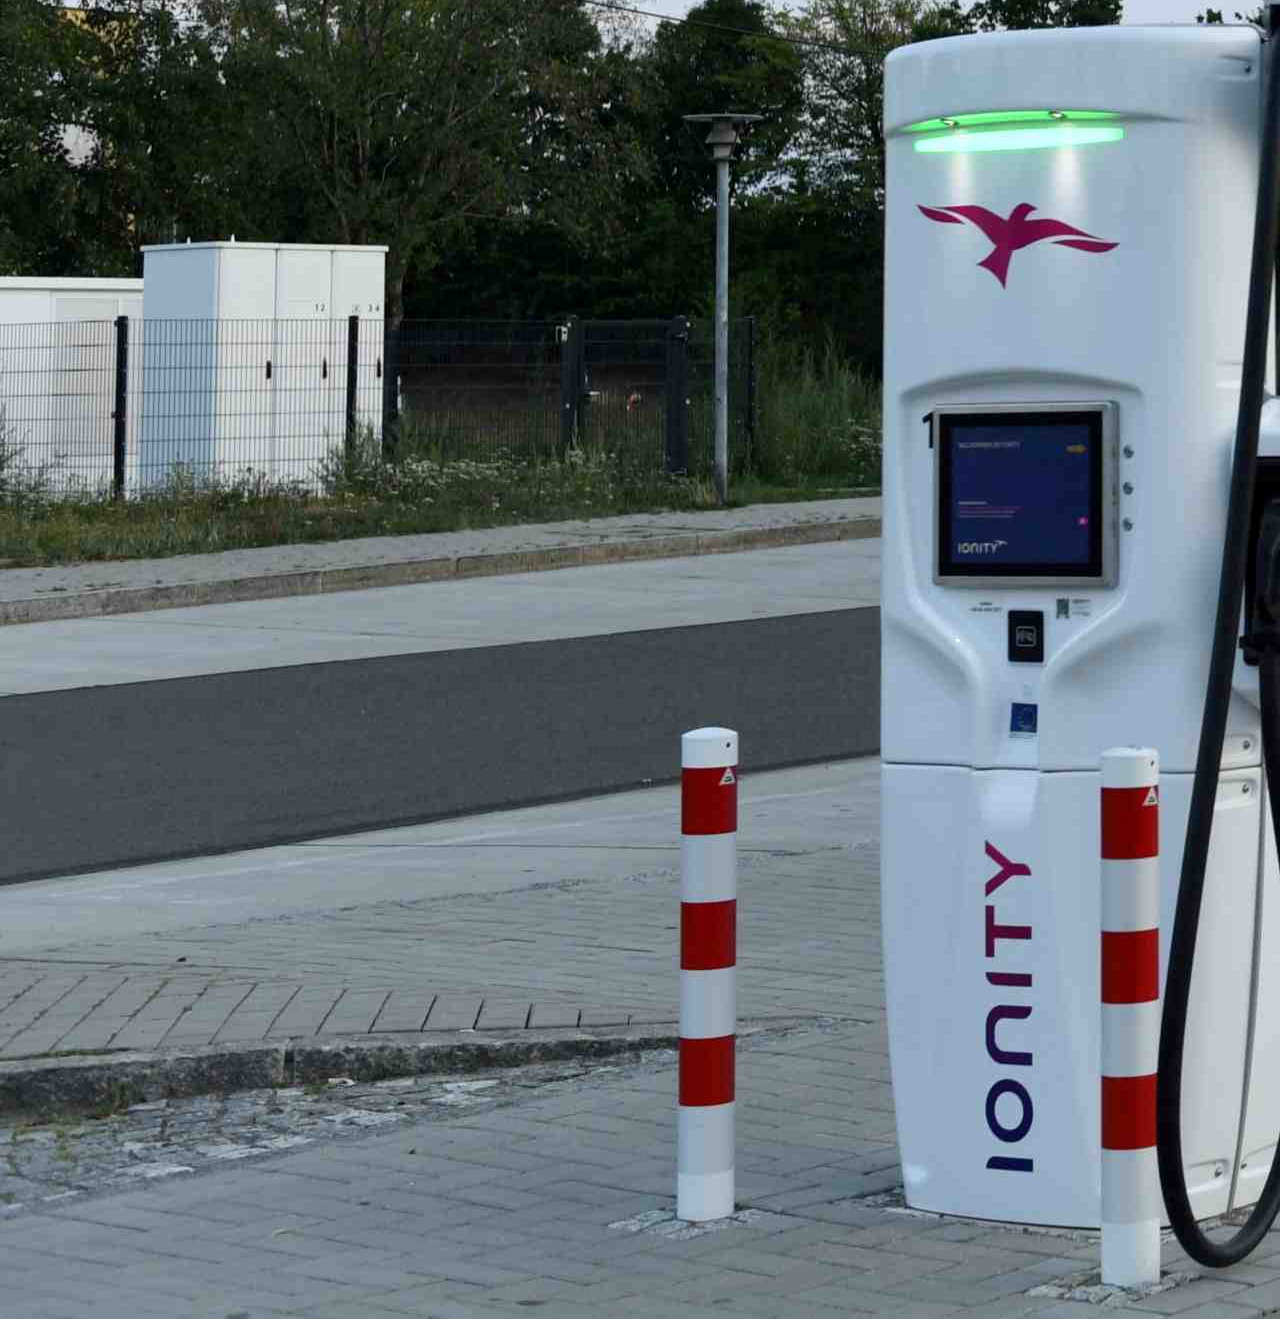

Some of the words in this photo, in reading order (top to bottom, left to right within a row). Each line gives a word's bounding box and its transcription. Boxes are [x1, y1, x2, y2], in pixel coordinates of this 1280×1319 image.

[922, 411, 935, 449] 1
[957, 541, 999, 555] IONITY
[984, 840, 1034, 1173] IONITY
